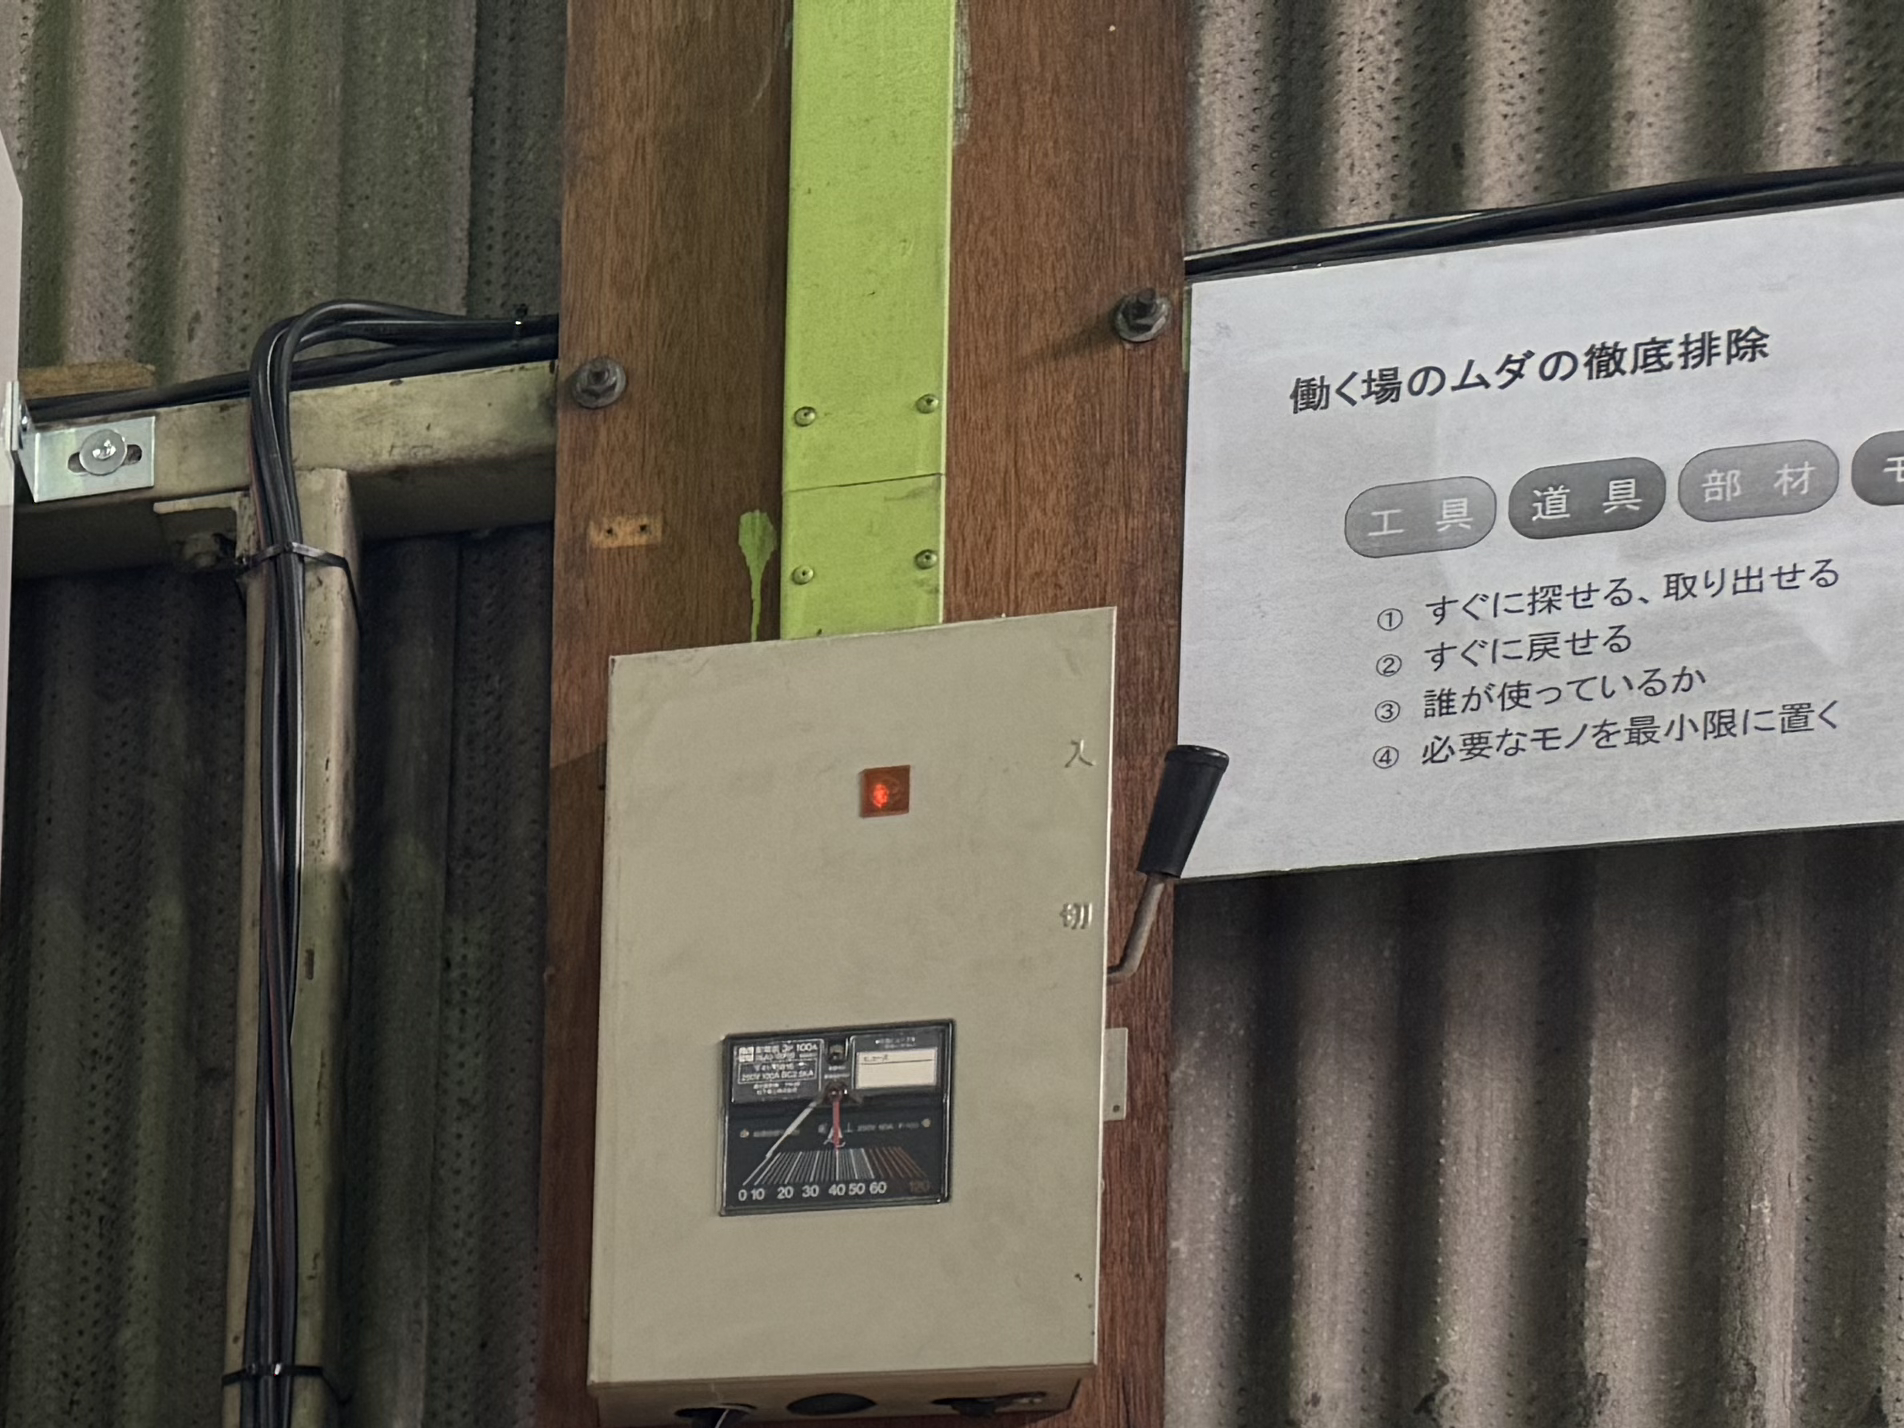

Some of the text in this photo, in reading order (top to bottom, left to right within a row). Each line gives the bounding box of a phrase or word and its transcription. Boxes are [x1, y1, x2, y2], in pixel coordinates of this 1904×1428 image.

[1289, 325, 1771, 415] 働く場のムダの徹底排除
[1426, 558, 1841, 627] すぐに探せる、取り出せる
[1424, 624, 1633, 674] すぐに戻せる
[1423, 664, 1707, 720] 誰が使っているか
[1065, 738, 1096, 768] 入
[1421, 699, 1840, 768] 必要なモノを最小限に置く
[797, 1042, 818, 1052] 100A
[738, 1189, 747, 1201] 0
[751, 1187, 765, 1200] 10
[777, 1186, 794, 1199] 20
[802, 1184, 819, 1197] 30
[828, 1183, 845, 1196] 40
[849, 1182, 865, 1195] 50
[869, 1181, 887, 1194] 60
